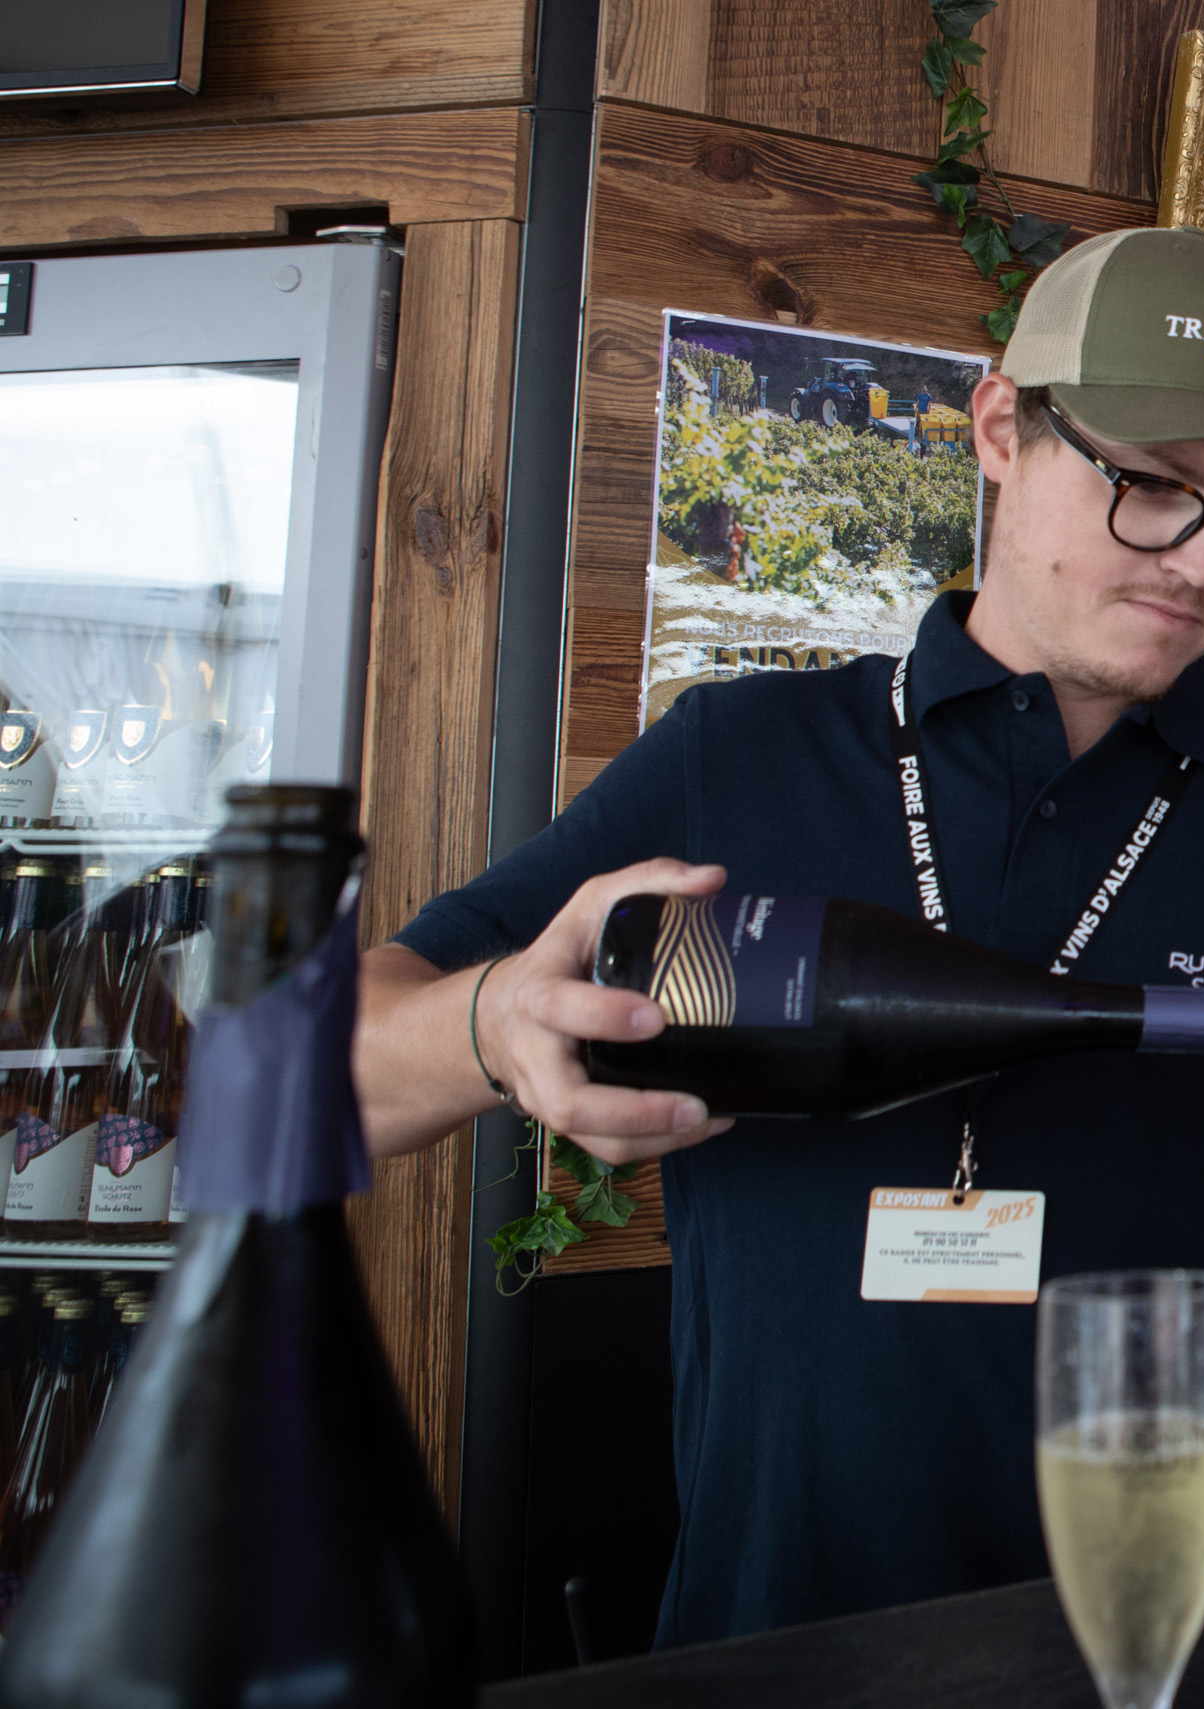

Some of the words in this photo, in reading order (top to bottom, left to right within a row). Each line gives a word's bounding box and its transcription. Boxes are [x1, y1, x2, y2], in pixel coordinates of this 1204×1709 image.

[685, 622, 739, 638] NOUS
[743, 624, 856, 645] RECRUTONS
[860, 633, 908, 652] POUR
[899, 755, 925, 816] FOIRE
[1152, 799, 1171, 824] 1948
[907, 820, 933, 865] AUX
[917, 867, 944, 921] VINS
[1060, 910, 1100, 960] VINS
[1090, 820, 1158, 914] D'ALSACE
[875, 1192, 948, 1208] EXPOSANT
[985, 1196, 1038, 1229] 2025
